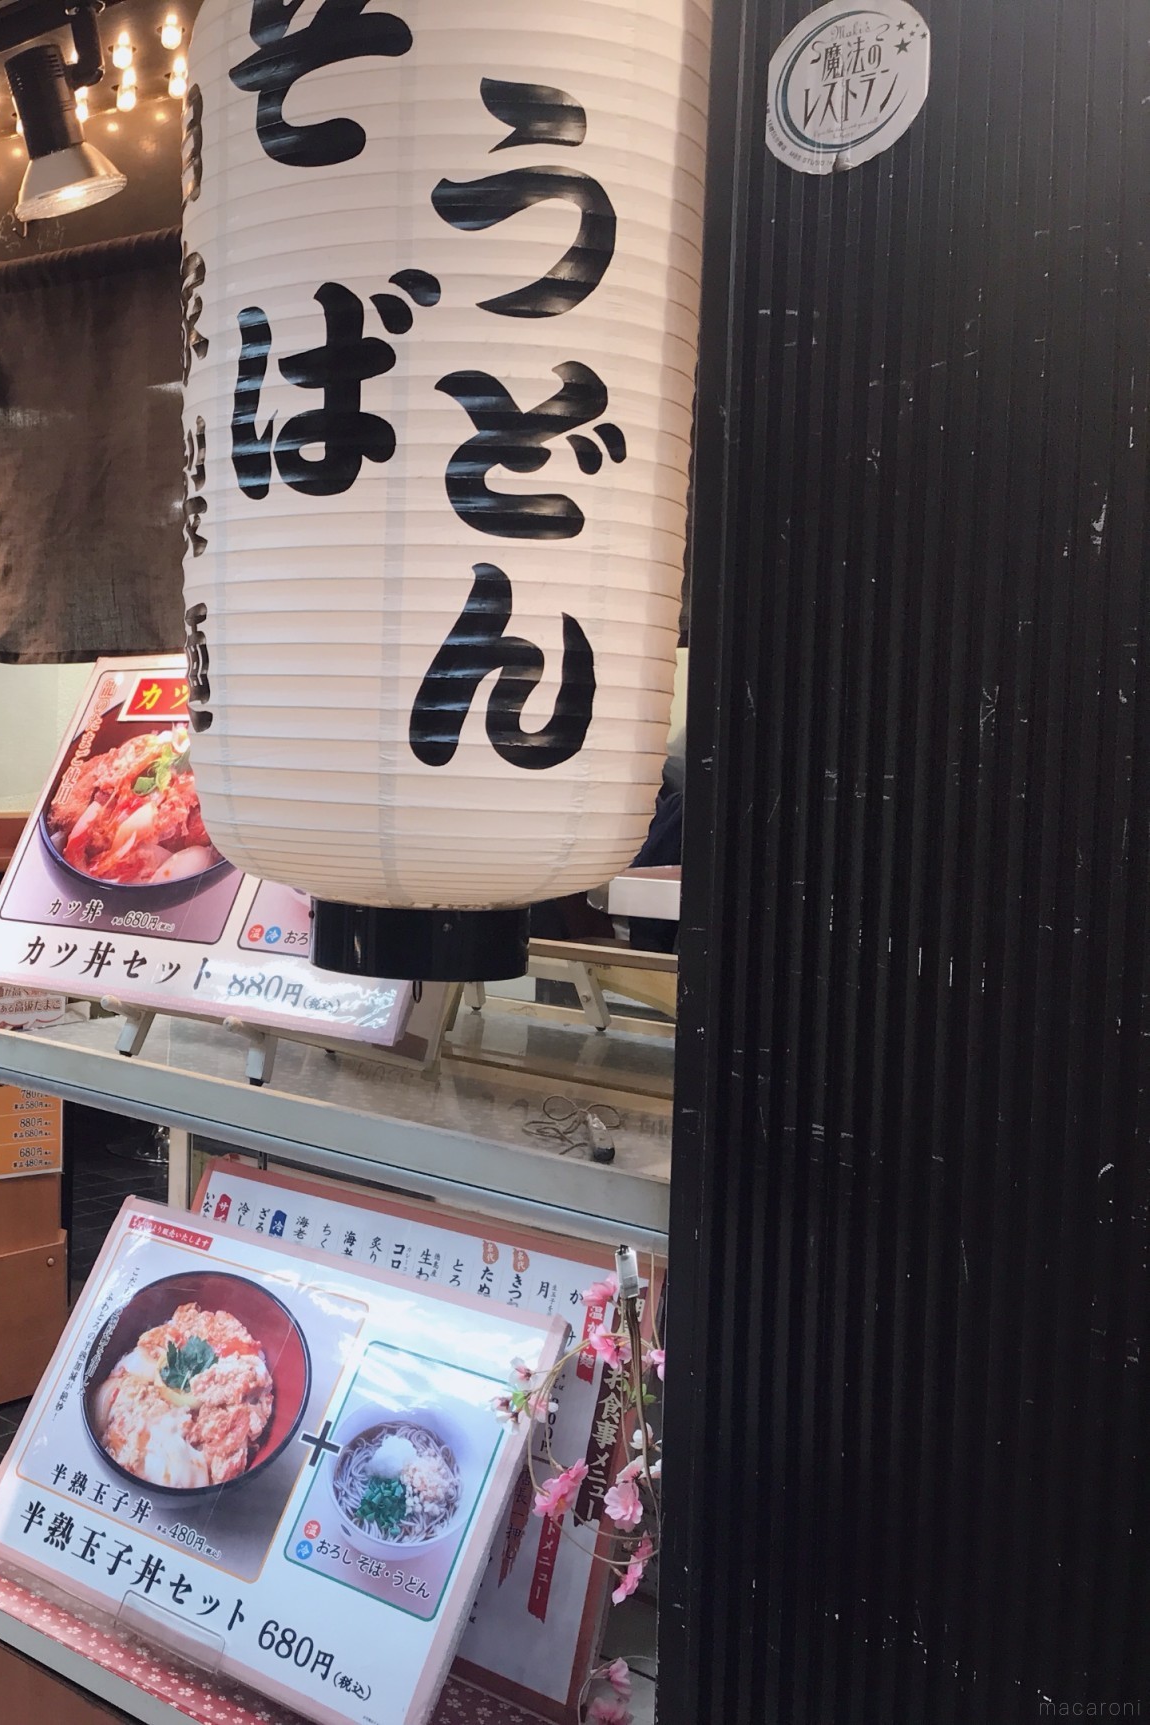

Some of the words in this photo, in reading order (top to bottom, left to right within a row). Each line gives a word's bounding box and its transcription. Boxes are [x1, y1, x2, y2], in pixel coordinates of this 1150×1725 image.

[822, 36, 882, 81] 魔法の
[803, 69, 900, 130] レストラン
[229, 0, 442, 500] そば
[409, 77, 627, 770] うどん
[47, 898, 104, 923] カツ丼
[18, 935, 212, 991] カツ丼セット
[506, 1273, 524, 1307] きつ
[50, 1463, 153, 1524] 半熟玉子丼
[20, 1500, 245, 1631] 半熟玉子丼セット
[316, 1538, 352, 1565] おろし
[357, 1555, 430, 1599] そば・うどん
